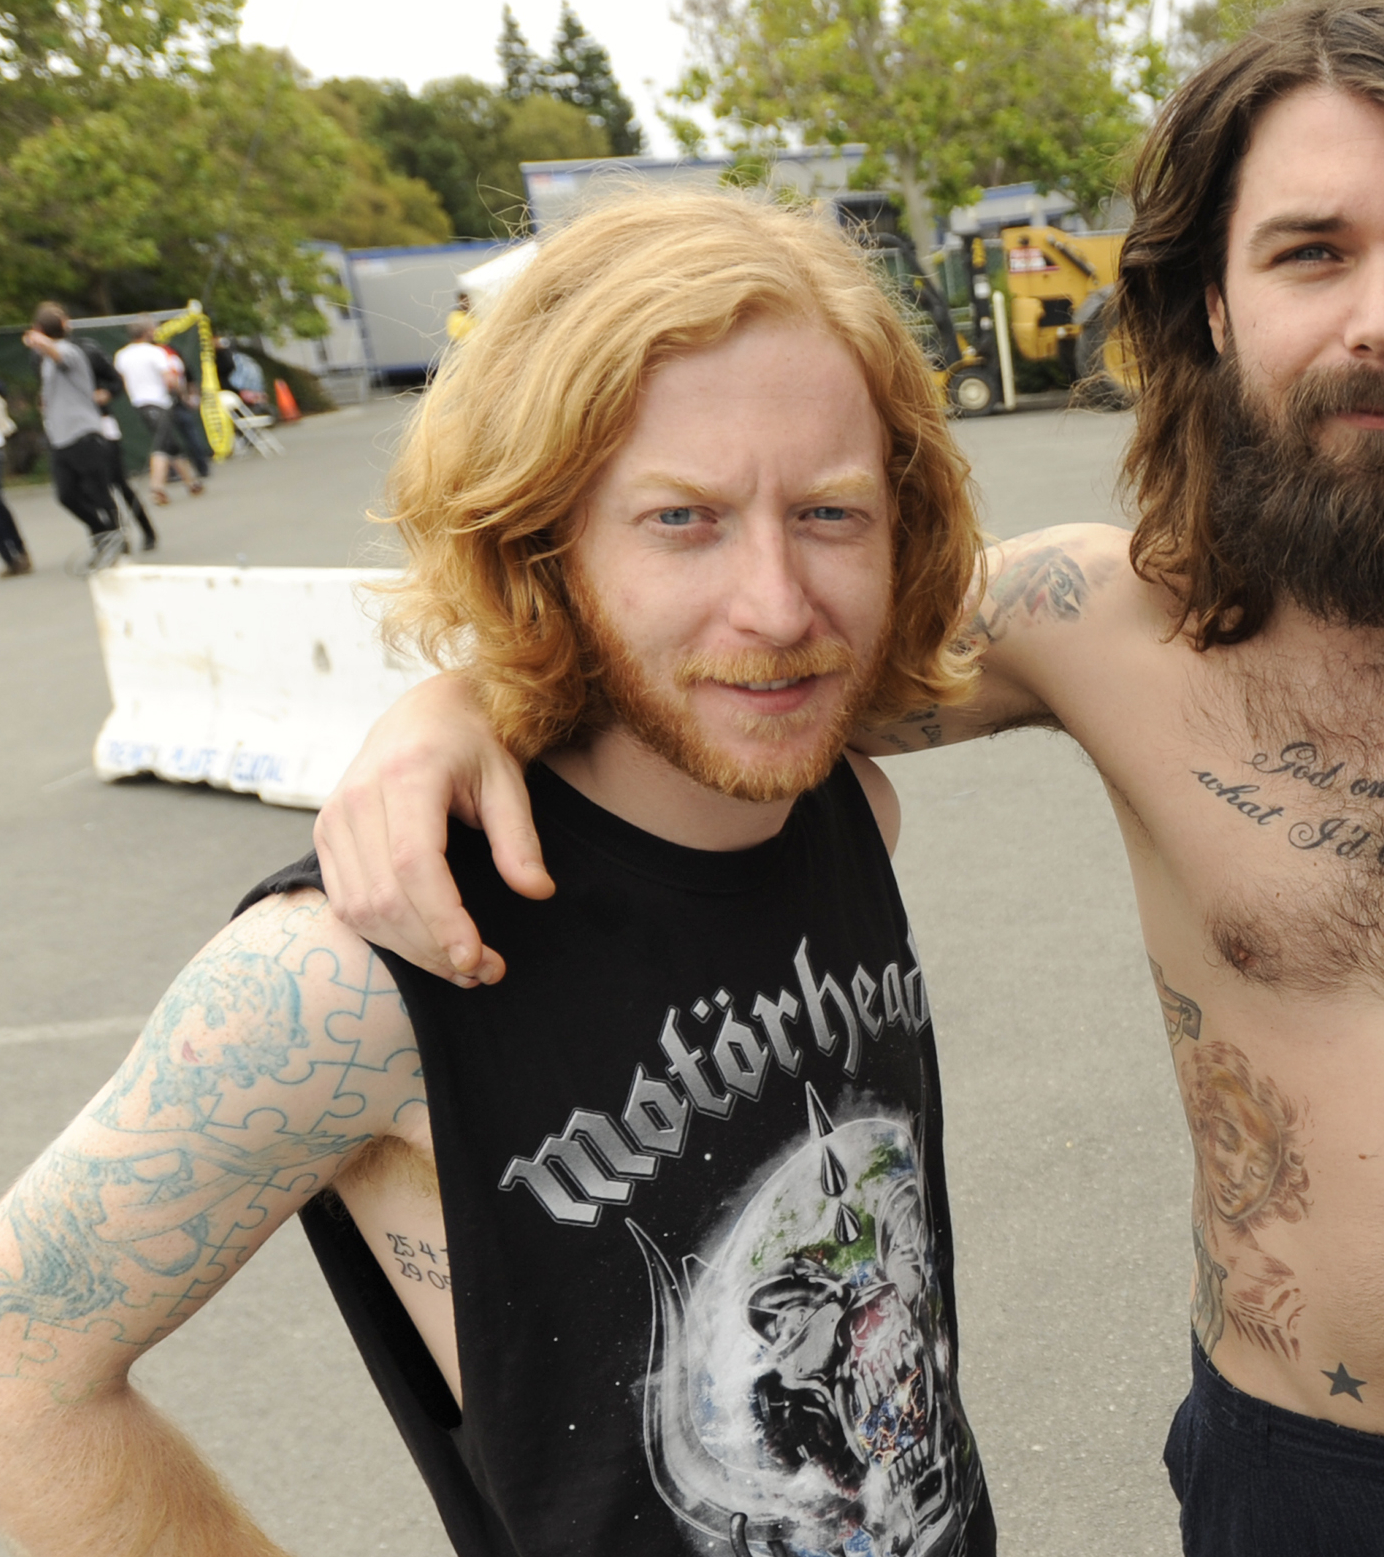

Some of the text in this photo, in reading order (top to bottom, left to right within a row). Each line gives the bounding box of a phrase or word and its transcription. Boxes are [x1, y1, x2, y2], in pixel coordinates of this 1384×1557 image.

[1241, 741, 1345, 790] God
[1189, 769, 1285, 826] what
[1288, 818, 1372, 859] I'd
[386, 1232, 416, 1258] 25
[394, 1257, 423, 1283] 29
